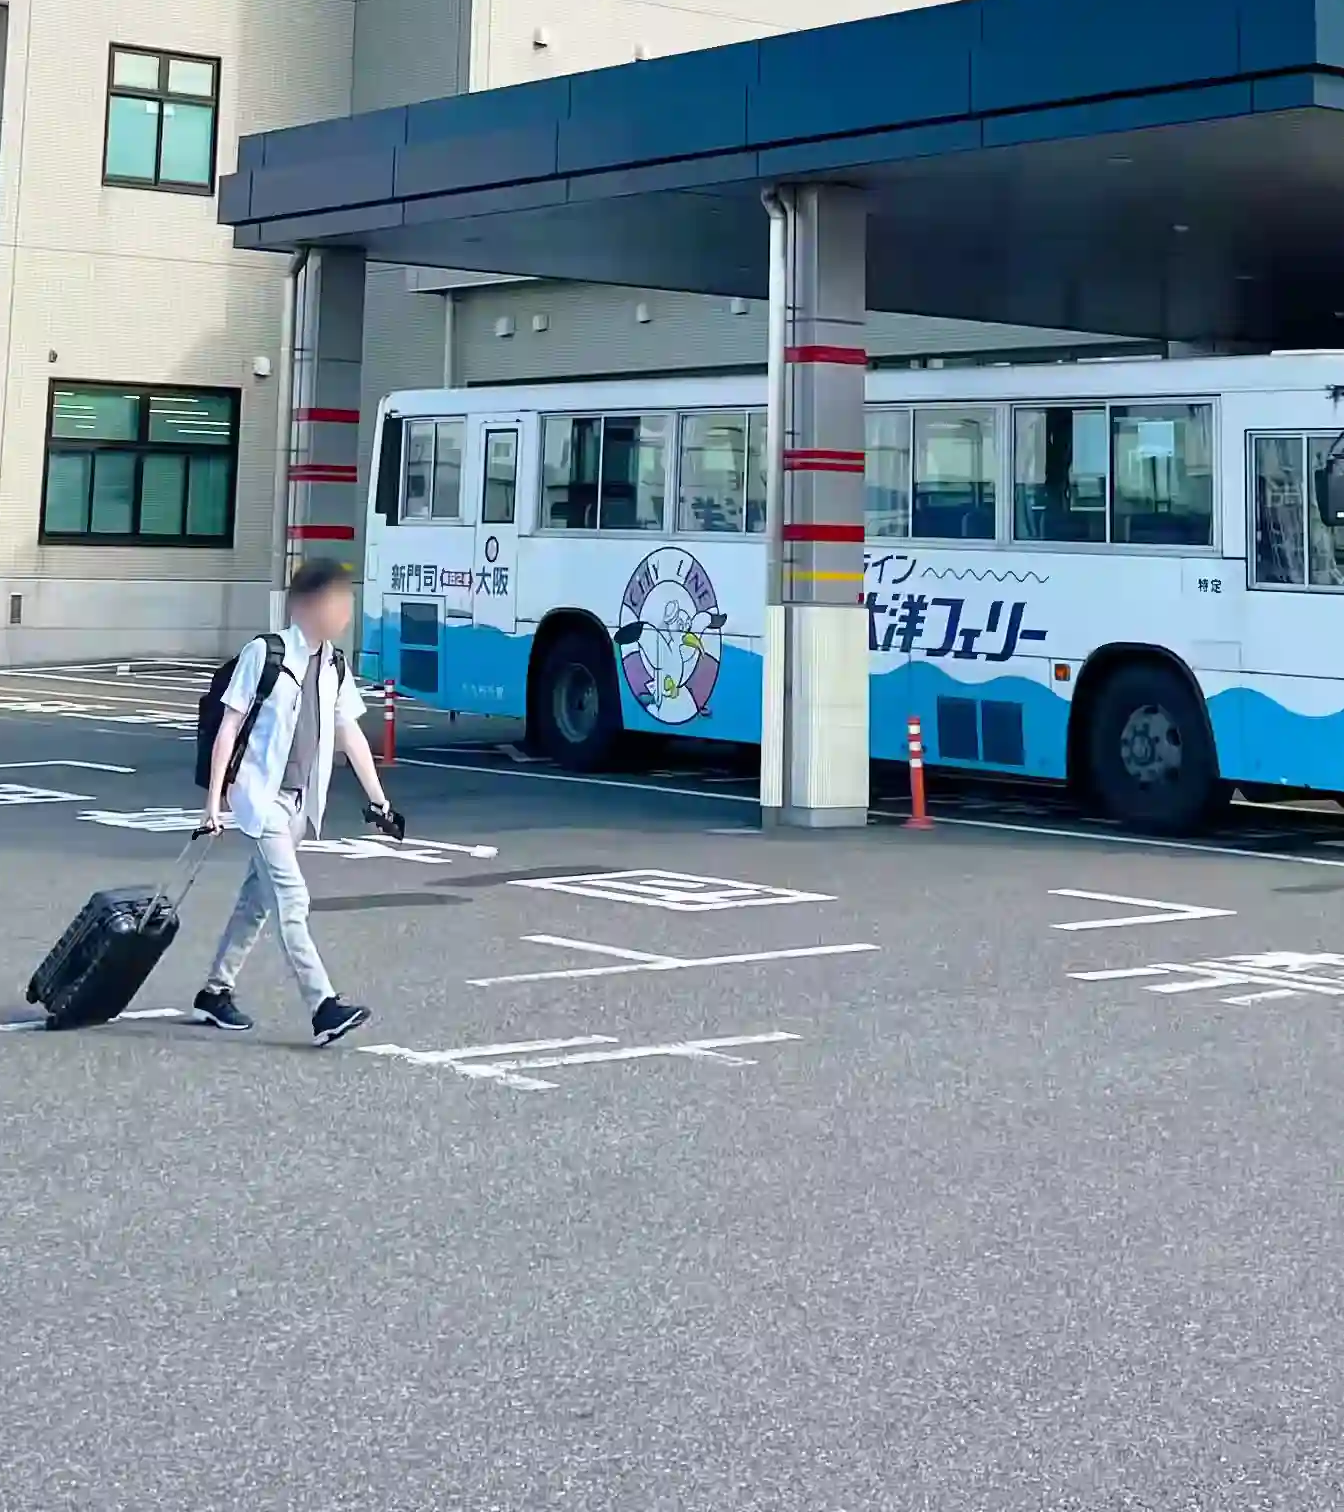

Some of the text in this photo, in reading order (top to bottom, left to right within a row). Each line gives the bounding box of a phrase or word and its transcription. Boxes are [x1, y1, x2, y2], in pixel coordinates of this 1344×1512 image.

[391, 564, 438, 593] 新門司
[475, 565, 509, 597] 大阪
[1197, 578, 1223, 594] 特定
